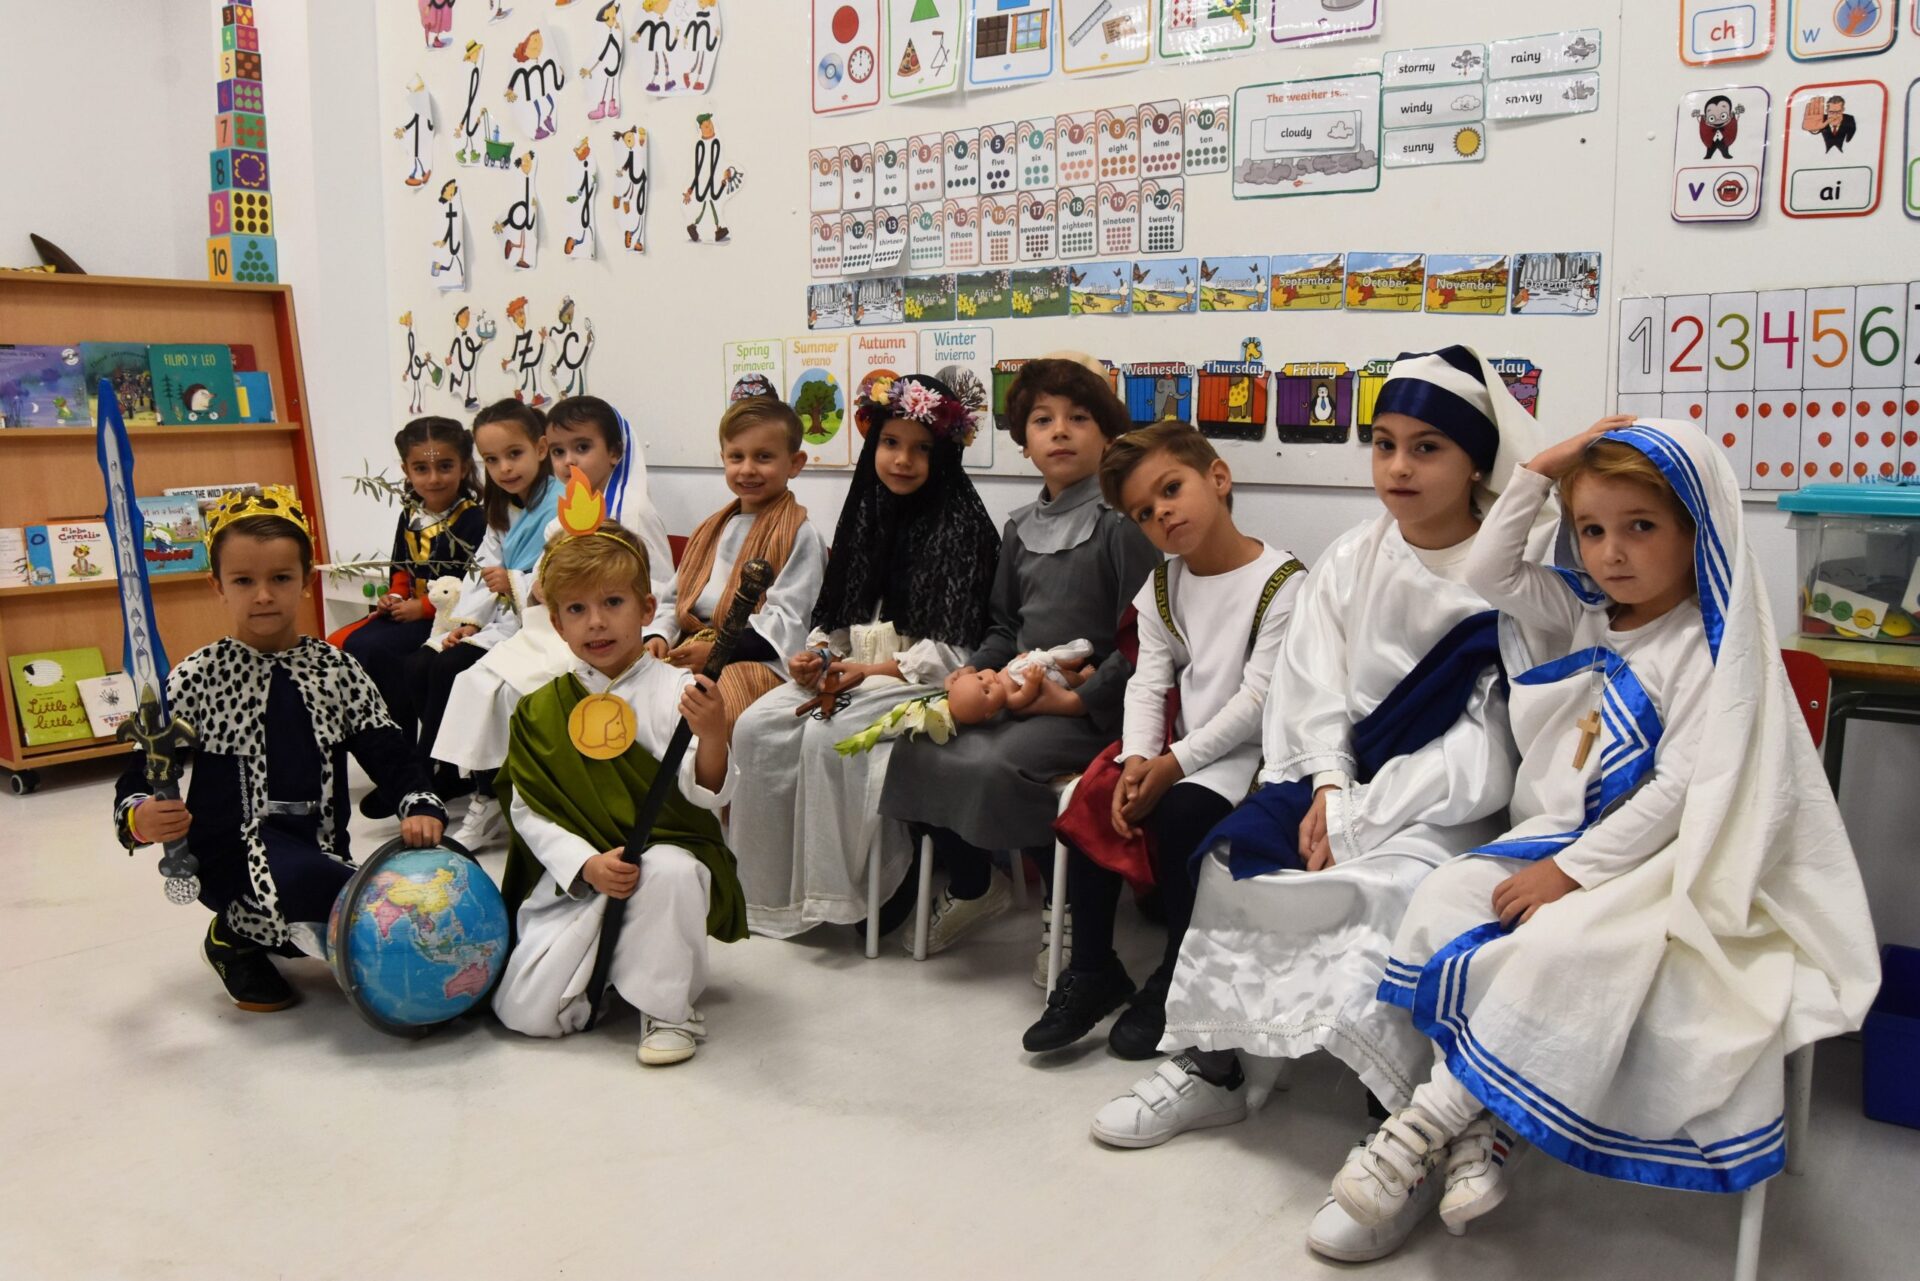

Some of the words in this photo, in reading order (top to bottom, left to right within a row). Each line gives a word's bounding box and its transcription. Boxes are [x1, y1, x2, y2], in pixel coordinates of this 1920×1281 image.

[636, 20, 678, 52] n
[684, 11, 718, 52] ñ
[1710, 20, 1736, 41] ch
[1802, 28, 1820, 44] w
[598, 33, 621, 77] s
[1510, 50, 1542, 65] rainy
[225, 57, 231, 74] 5
[1398, 61, 1436, 75] stormy
[508, 58, 565, 102] m
[1266, 92, 1284, 104] The
[1286, 89, 1328, 102] weather
[1505, 92, 1543, 106] snowy
[1400, 101, 1433, 115] windy
[1157, 118, 1164, 129] 9
[1199, 114, 1212, 125] 10
[220, 119, 228, 144] 7
[1073, 130, 1080, 138] 7
[1114, 124, 1121, 134] 8
[1280, 126, 1313, 140] cloudy
[995, 140, 1001, 148] 5
[1033, 135, 1040, 144] 6
[1153, 139, 1170, 148] nine
[1200, 136, 1214, 144] ten
[922, 150, 928, 158] 3
[958, 146, 964, 154] 4
[1108, 144, 1128, 154] eight
[1402, 141, 1435, 154] sunny
[854, 160, 859, 168] 1
[888, 155, 894, 164] 2
[1031, 154, 1042, 162] six
[216, 158, 225, 185] 8
[690, 138, 727, 203] ll
[954, 164, 969, 172] four
[623, 150, 648, 216] y
[577, 160, 598, 229] j
[1688, 182, 1705, 202] v
[1819, 180, 1842, 202] ai
[501, 177, 536, 231] d
[1072, 202, 1083, 212] 18
[1112, 197, 1124, 208] 19
[1155, 194, 1170, 206] 20
[214, 198, 224, 228] 9
[956, 212, 966, 222] 15
[994, 210, 1004, 220] 16
[1032, 206, 1042, 216] 17
[887, 220, 897, 230] 13
[921, 216, 931, 226] 14
[1062, 221, 1093, 231] eighteen
[1102, 216, 1136, 226] nineteen
[1148, 215, 1176, 224] twenty
[822, 228, 831, 236] 11
[854, 226, 863, 235] 12
[1020, 224, 1055, 234] seventeen
[913, 235, 941, 243] fourteen
[212, 247, 228, 277] 10
[1279, 275, 1336, 292] September
[1362, 275, 1408, 290] October
[1435, 276, 1497, 292] November
[1523, 276, 1586, 290] December
[1029, 286, 1050, 298] May
[858, 336, 907, 350] Autumn
[934, 331, 977, 346] Winter
[1628, 316, 1652, 374] 1
[1669, 315, 1704, 372] 2
[1714, 312, 1750, 371] 3
[1762, 310, 1800, 369] 4
[1812, 308, 1849, 368] 5
[1859, 306, 1900, 366] 6
[736, 343, 770, 358] Spring
[793, 340, 839, 354] Summer
[191, 355, 198, 366] Y
[201, 354, 217, 366] LEO
[801, 356, 832, 367] verano
[867, 352, 896, 365] otoño
[934, 349, 977, 362] invierno
[732, 360, 776, 374] primavera
[1122, 362, 1195, 378] Wednesday
[1204, 360, 1267, 378] Thursday
[1292, 364, 1338, 380] Friday
[27, 698, 68, 715] Little
[34, 714, 74, 729] little
